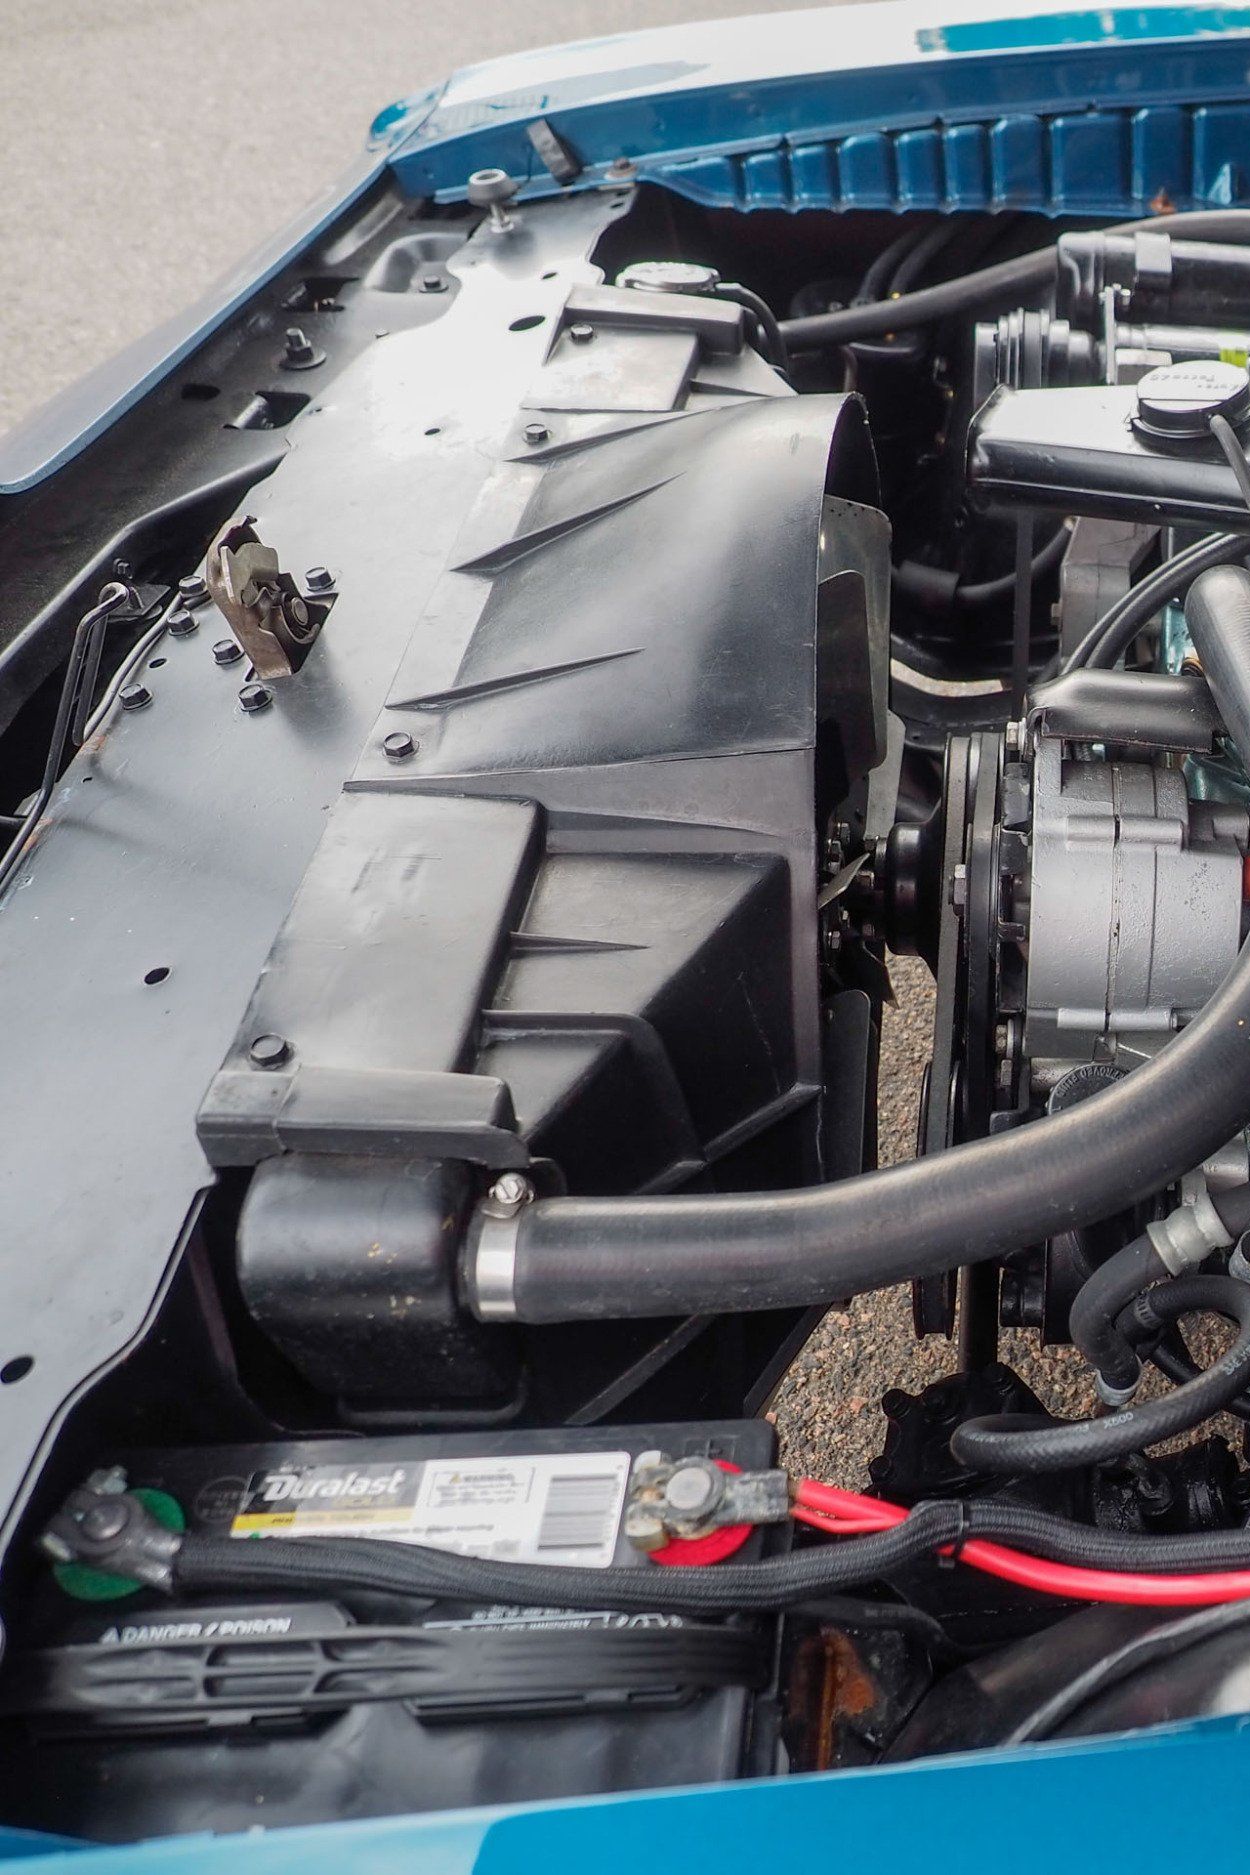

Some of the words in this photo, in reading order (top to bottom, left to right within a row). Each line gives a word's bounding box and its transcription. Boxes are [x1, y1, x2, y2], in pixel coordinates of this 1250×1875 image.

[1103, 1412, 1134, 1430] X500
[263, 1469, 405, 1501] Duralast
[121, 1623, 202, 1645] DANGER
